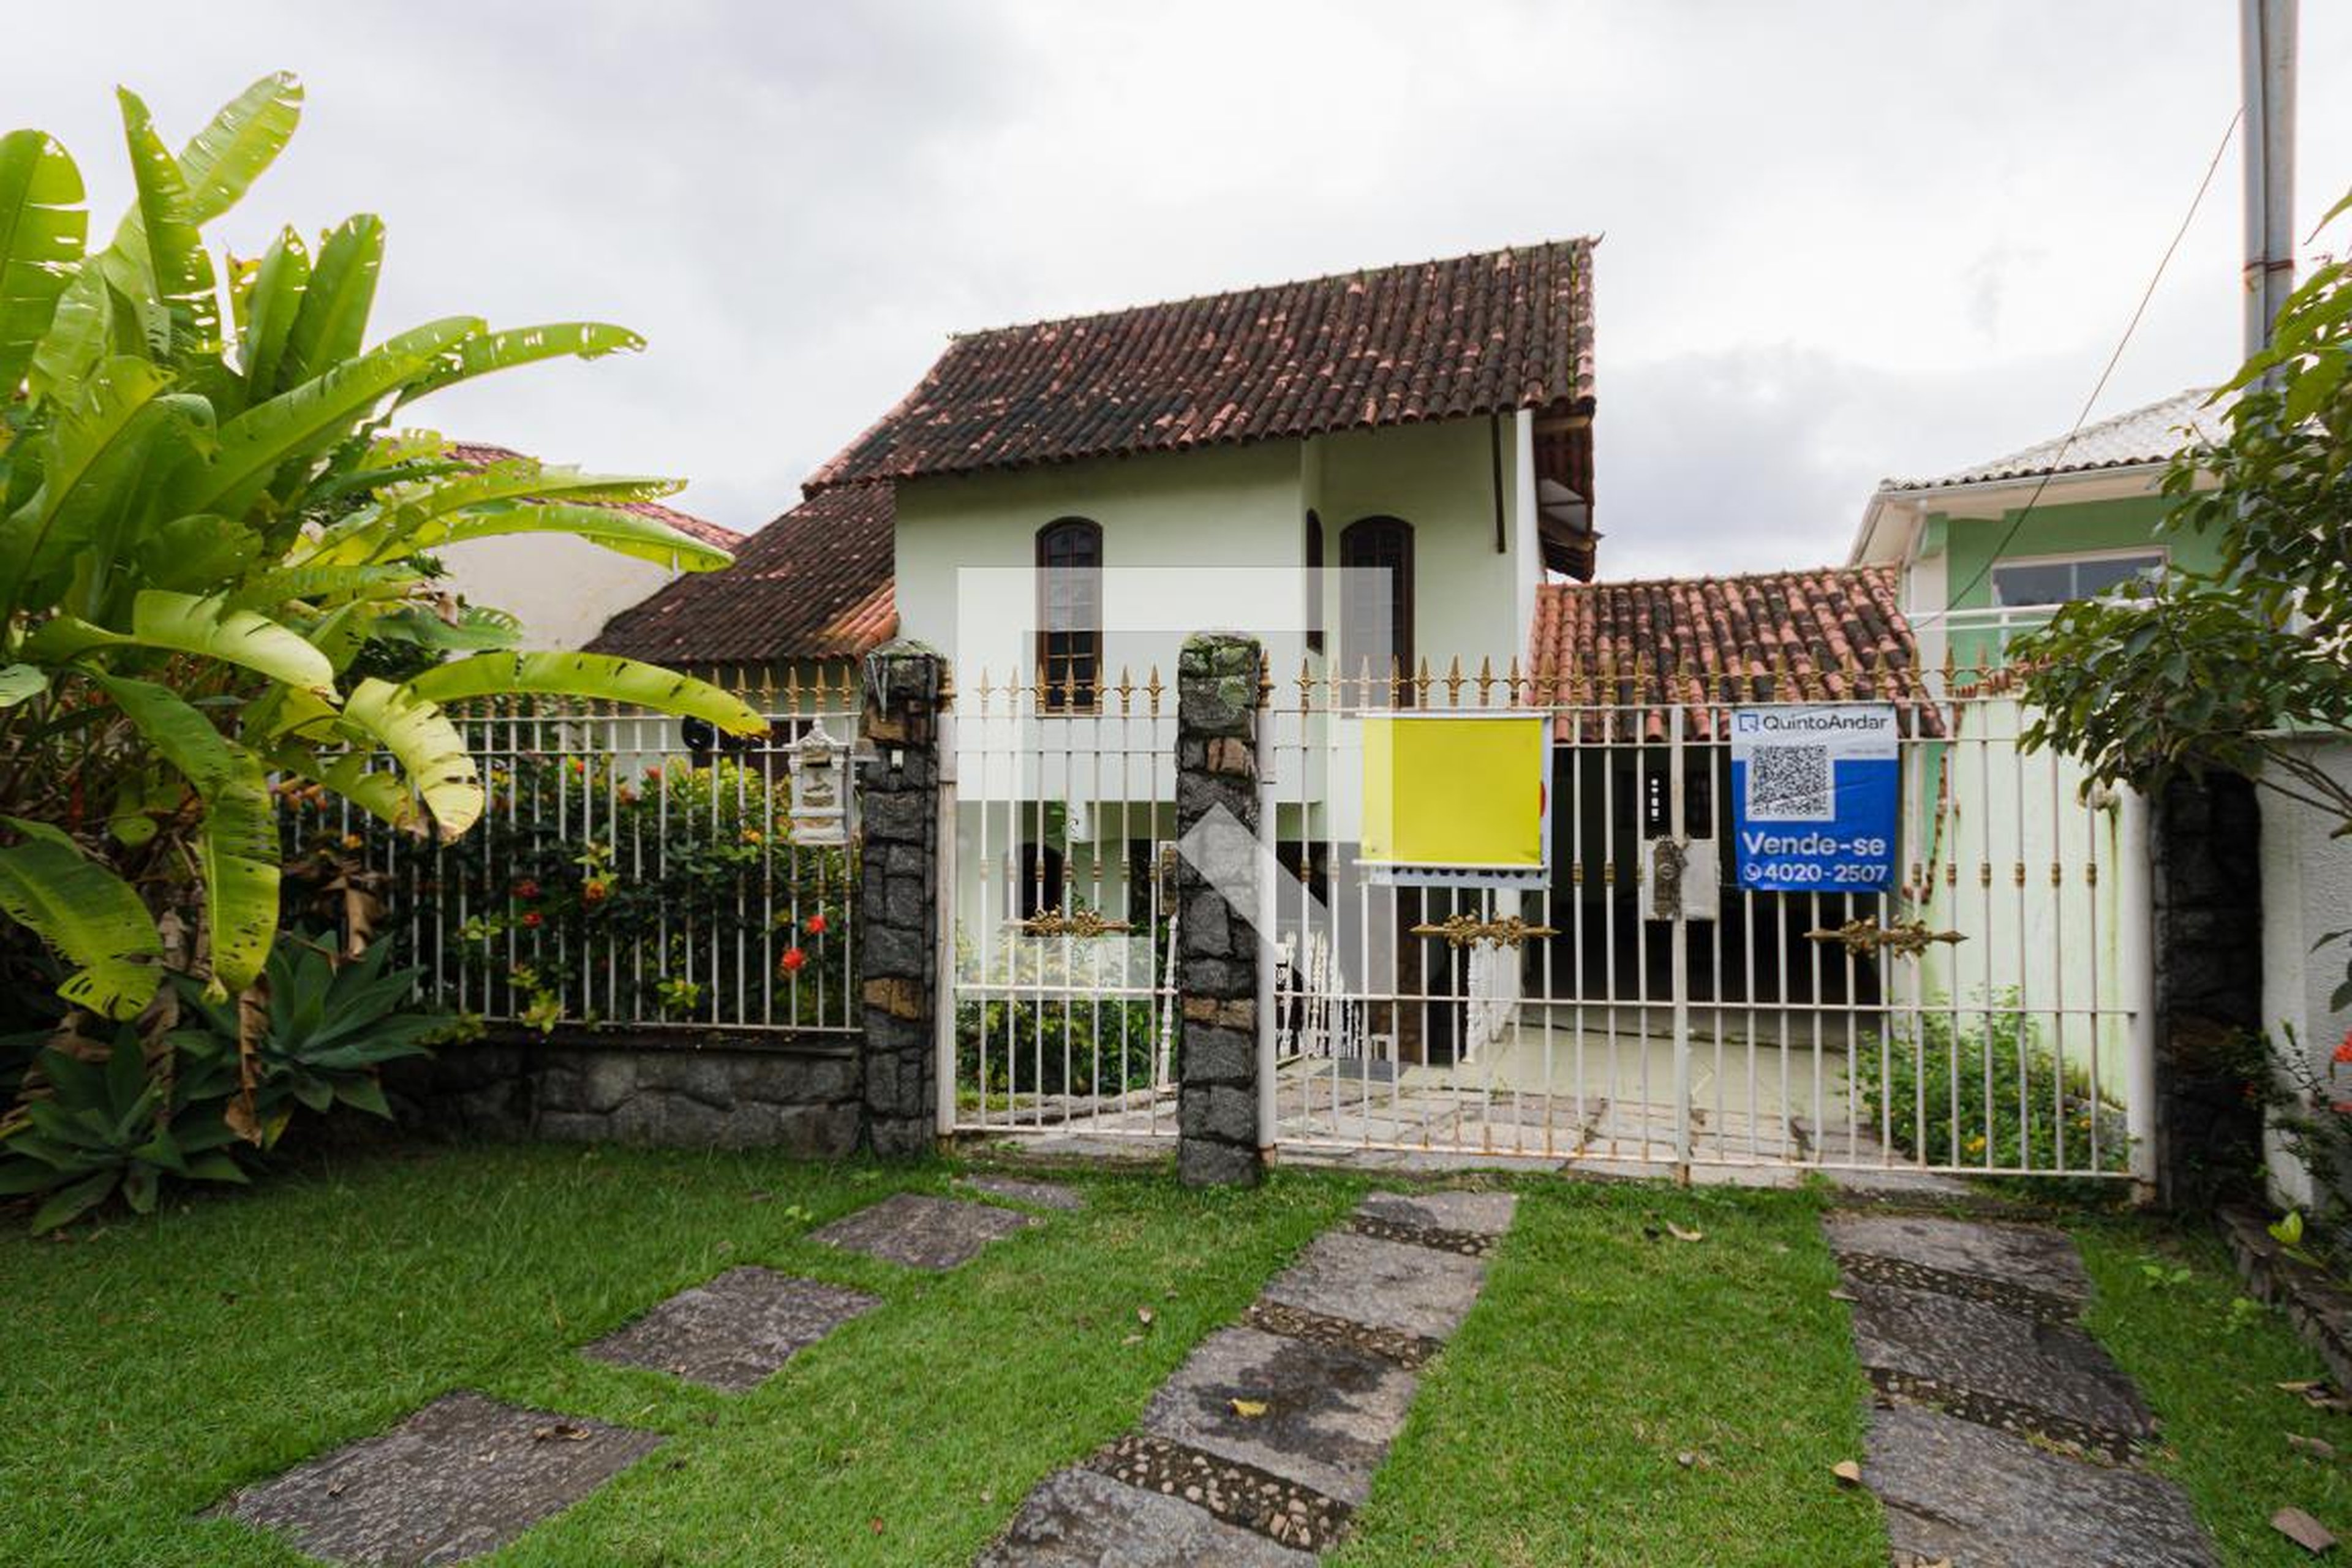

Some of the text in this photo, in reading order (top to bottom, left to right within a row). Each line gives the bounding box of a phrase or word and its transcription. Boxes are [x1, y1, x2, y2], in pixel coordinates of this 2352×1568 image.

[1763, 714, 1888, 730] QuintoAndar
[1742, 832, 1887, 856] Vende-se
[1763, 863, 1888, 883] 4020-2507
